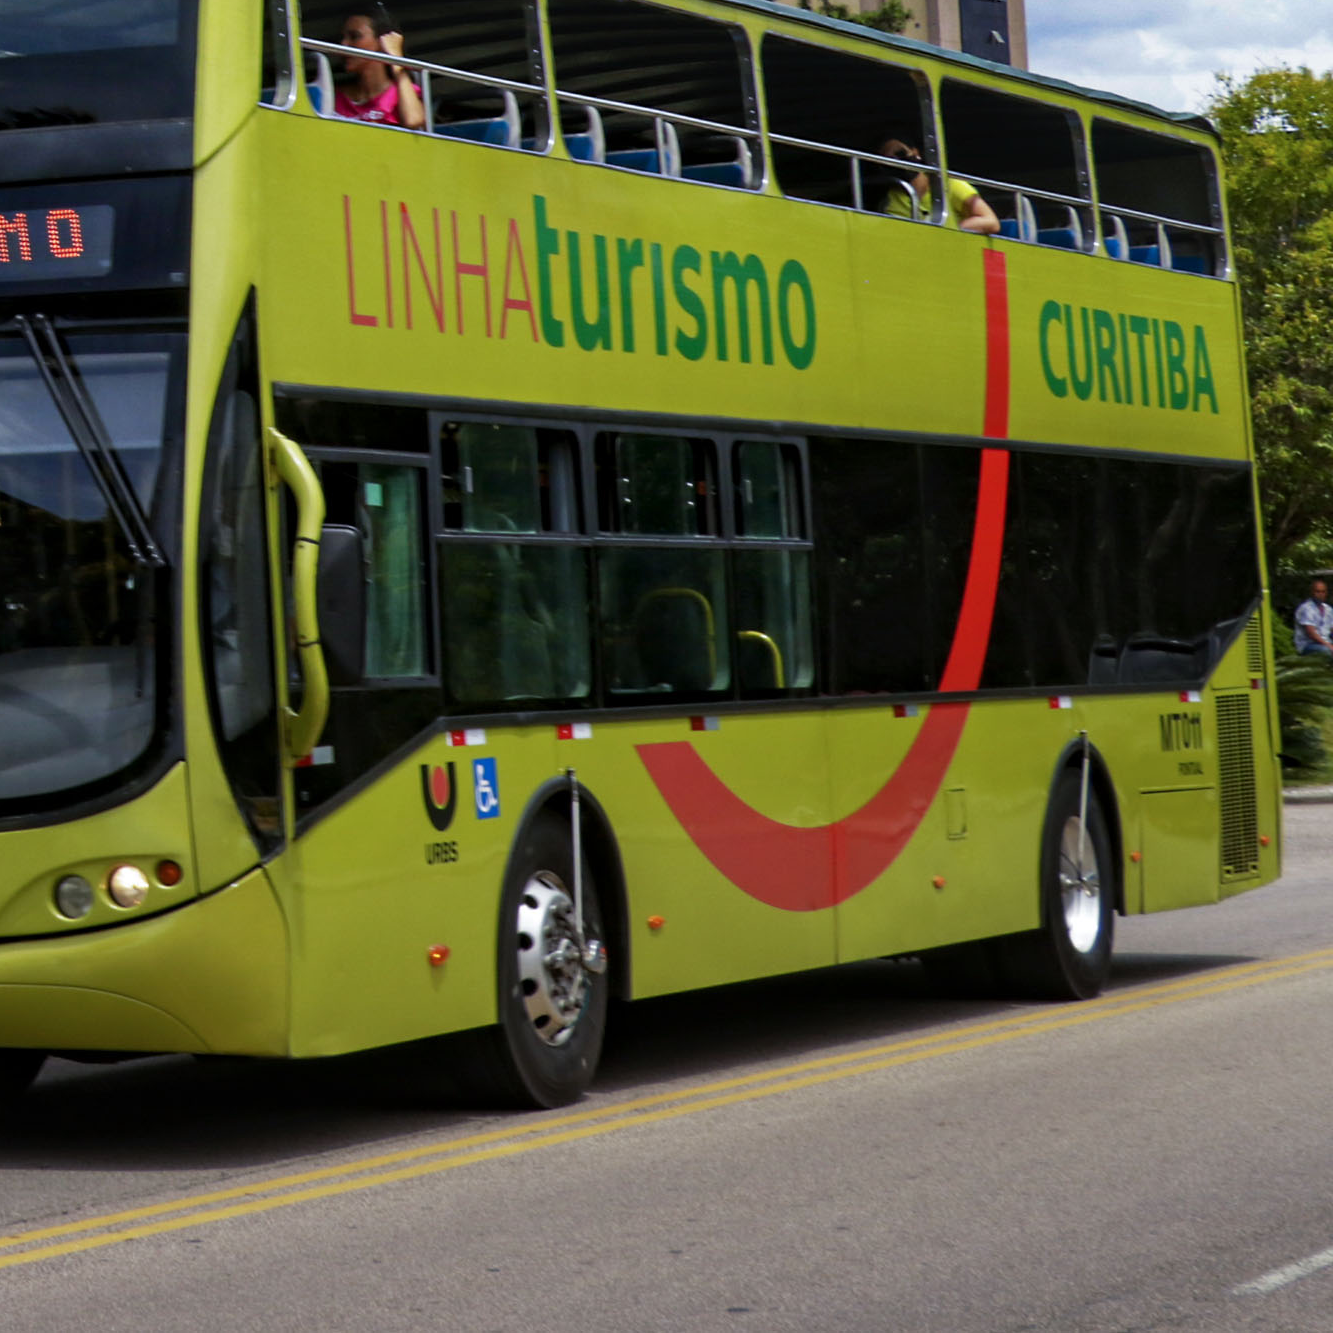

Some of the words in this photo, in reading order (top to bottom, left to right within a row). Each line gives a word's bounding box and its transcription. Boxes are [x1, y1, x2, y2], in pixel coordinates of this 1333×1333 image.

[344, 195, 538, 342] LINHA
[533, 195, 816, 370] turismo
[1039, 300, 1219, 415] CURITIBA
